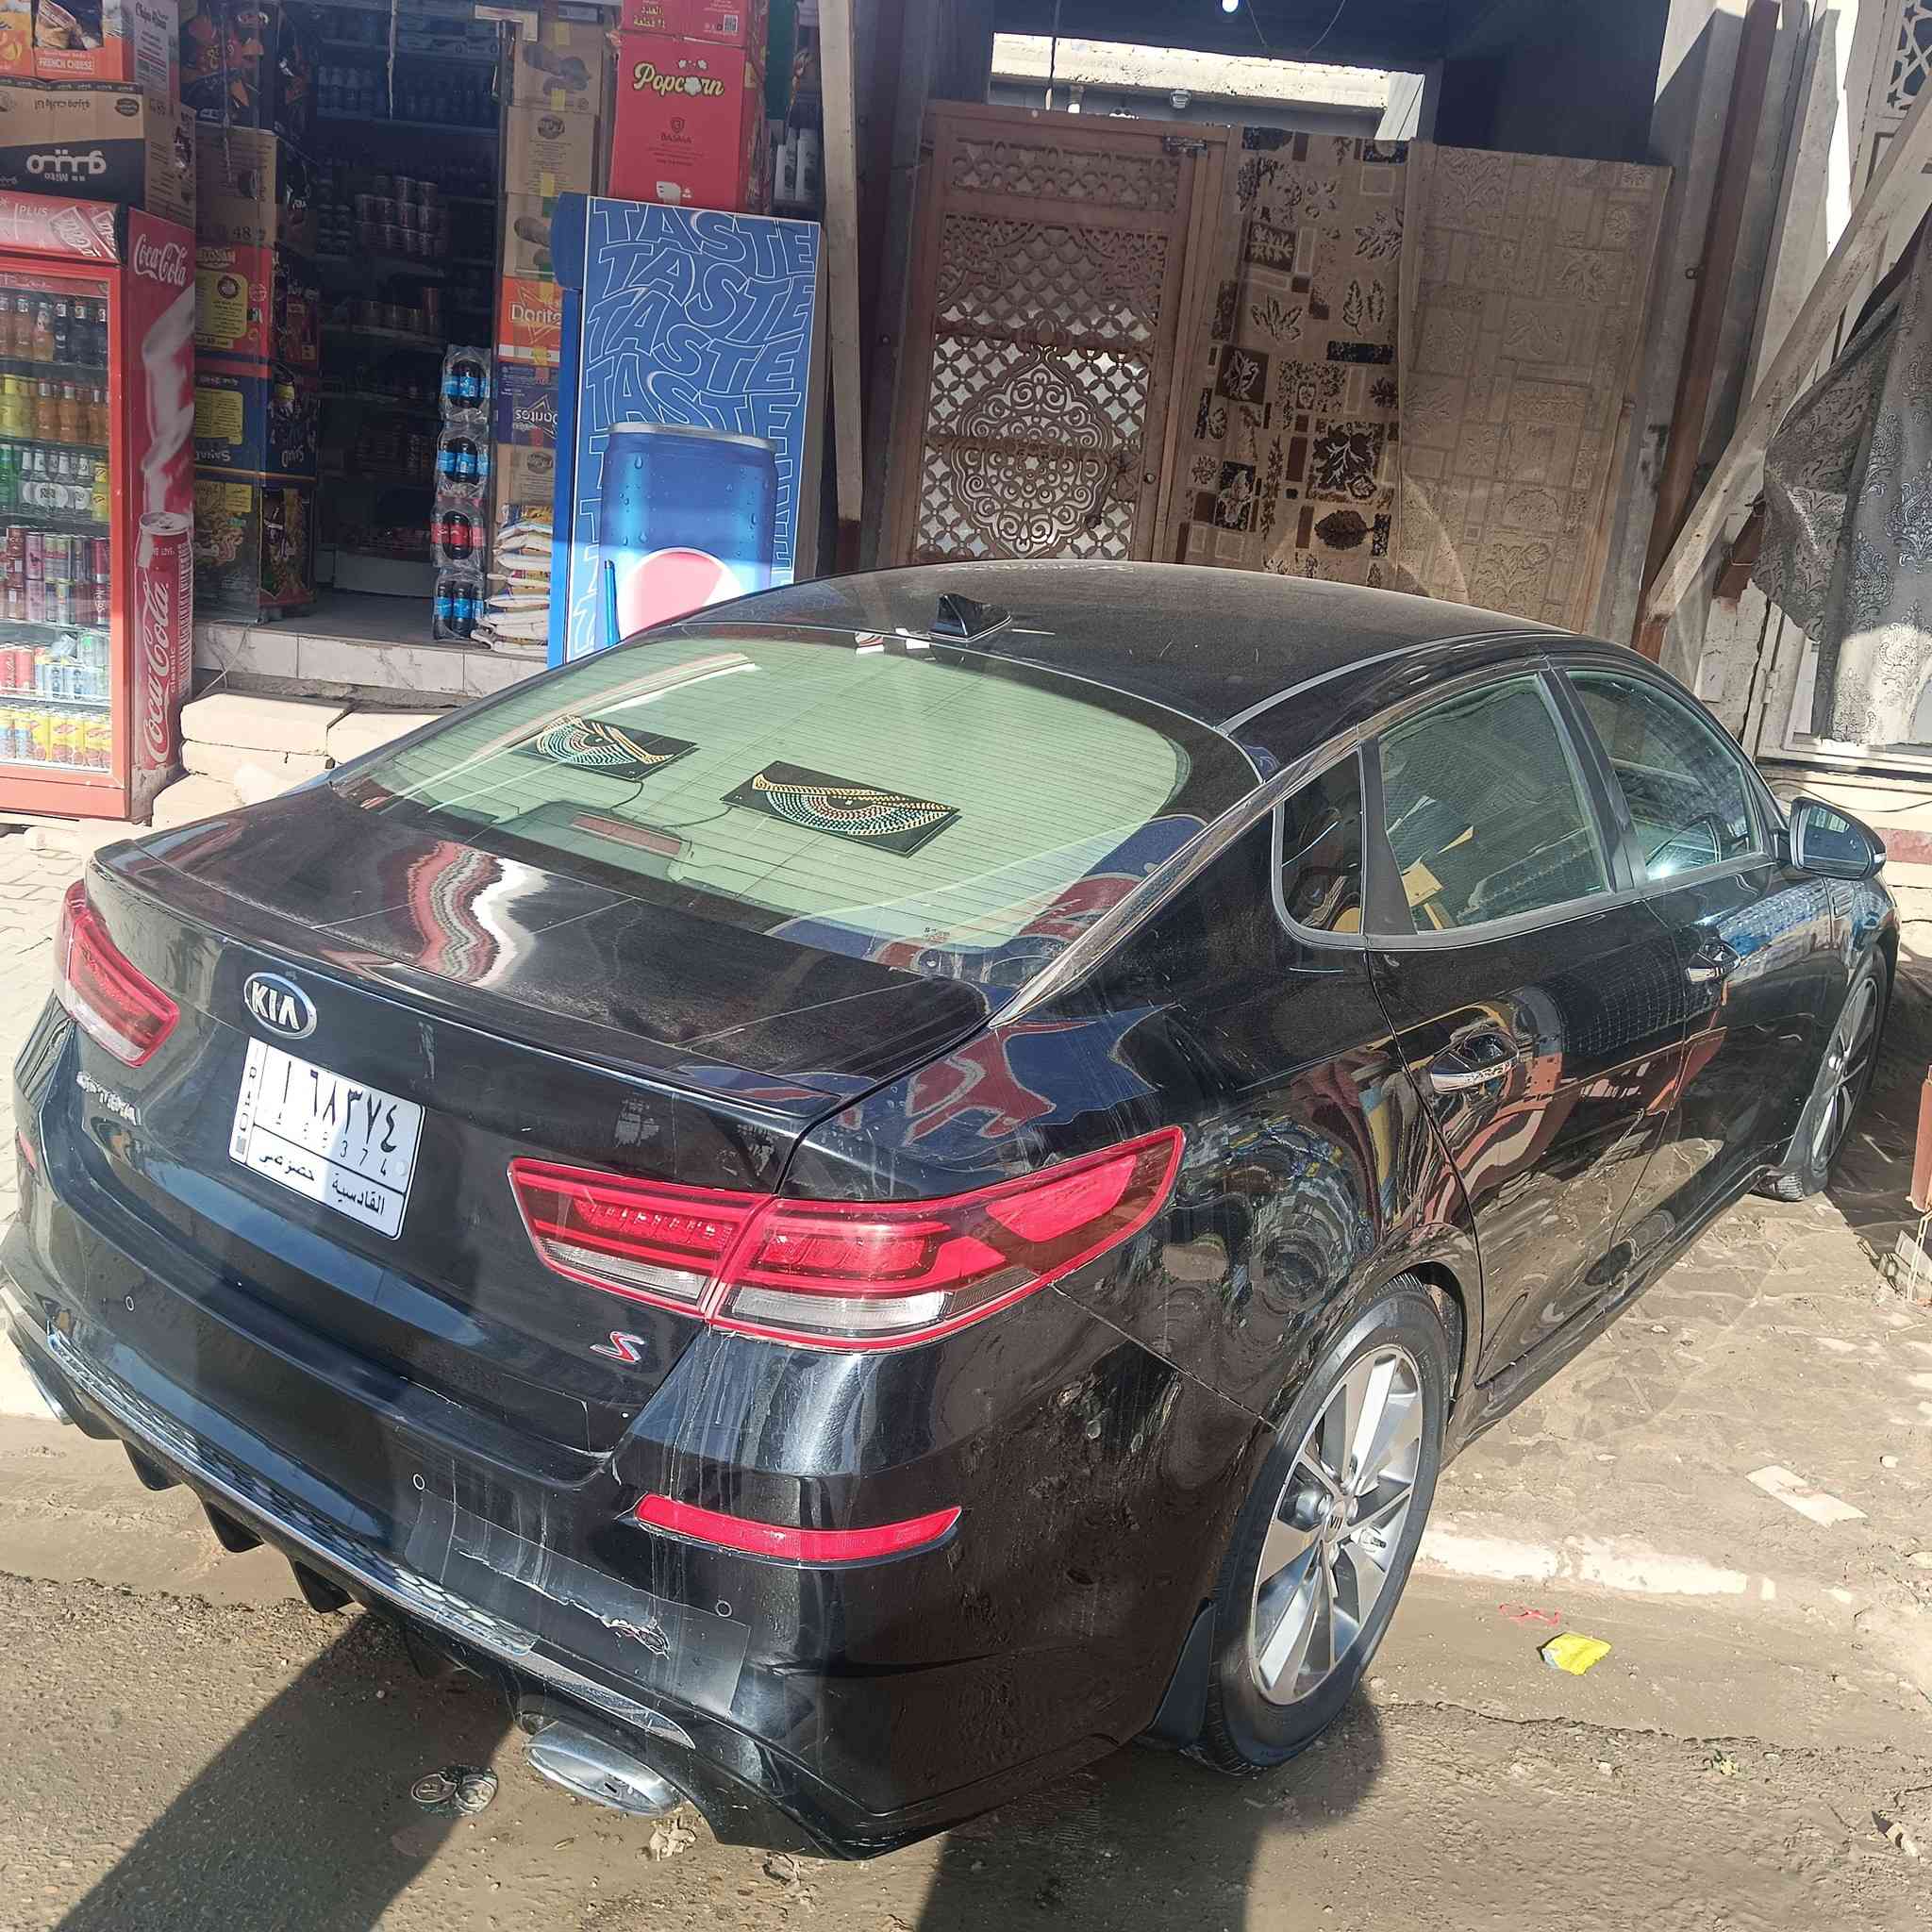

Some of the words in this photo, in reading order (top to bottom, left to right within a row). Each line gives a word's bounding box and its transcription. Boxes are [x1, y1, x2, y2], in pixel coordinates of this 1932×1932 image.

[634, 62, 725, 96] Popcorn
[19, 206, 48, 216] PLUS
[134, 233, 189, 287] Coca-Cola
[594, 199, 816, 279] TASTE
[599, 243, 816, 343] TASTE
[588, 288, 805, 394] TASTE
[143, 570, 171, 763] Coca-Cola
[251, 981, 301, 1030] KIA
[331, 1174, 386, 1216] القادسية
[590, 1330, 645, 1363] S
